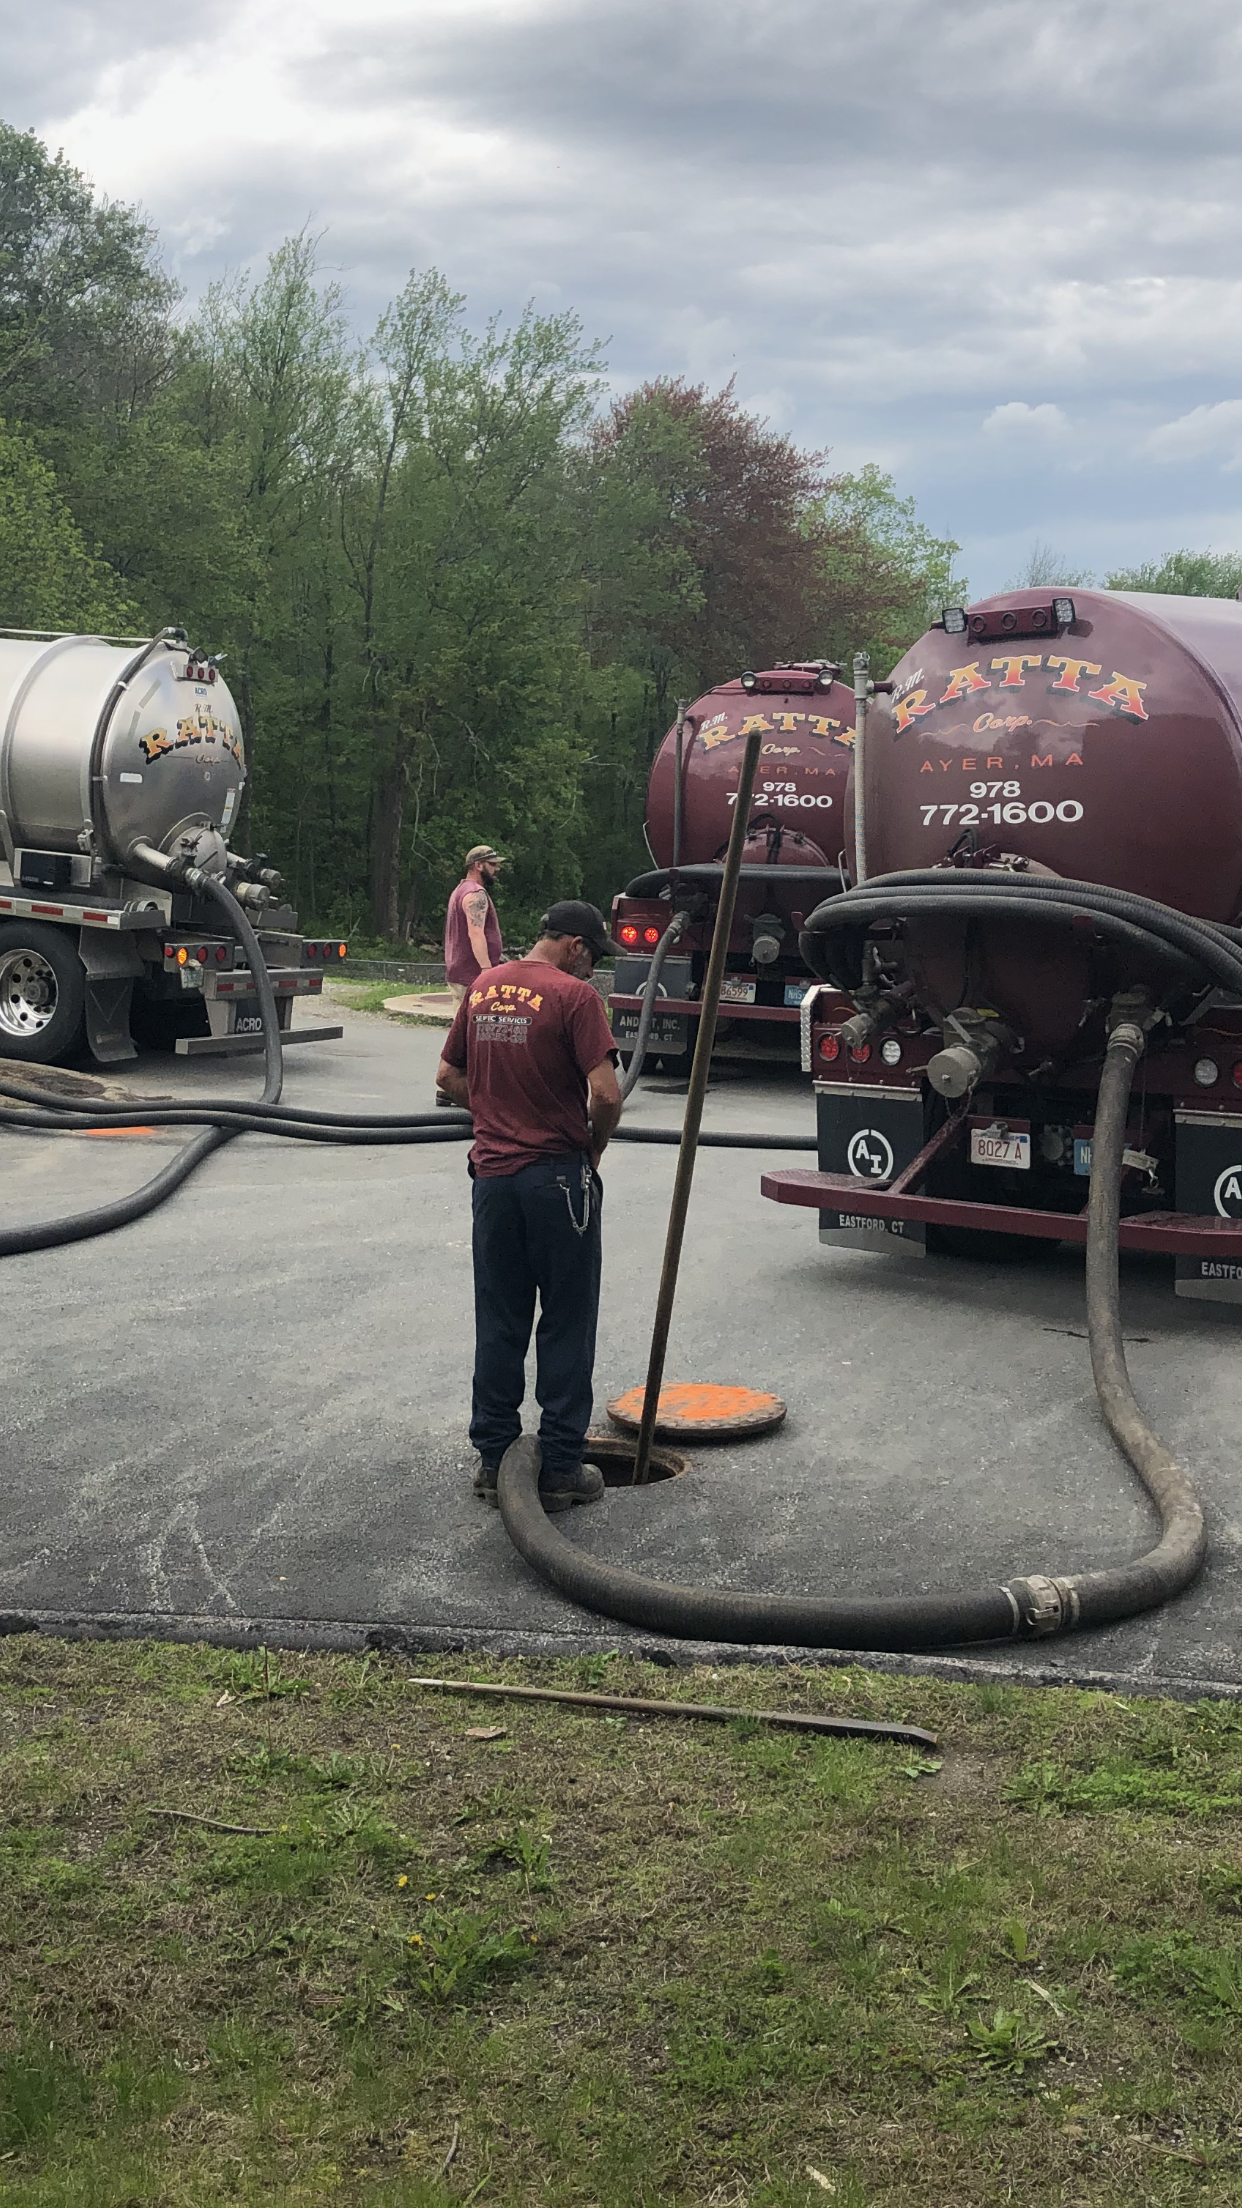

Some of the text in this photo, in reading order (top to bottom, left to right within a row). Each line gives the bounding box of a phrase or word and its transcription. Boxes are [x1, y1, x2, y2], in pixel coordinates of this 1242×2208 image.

[891, 668, 925, 703] R.M.
[892, 654, 1150, 736] RATTA
[700, 711, 728, 731] R.M.
[973, 713, 1033, 734] Corp.
[139, 716, 243, 768] RATTA
[761, 743, 801, 757] Corp.
[1031, 753, 1084, 767] MA
[728, 765, 836, 776] AER, MA
[762, 782, 797, 792] 978
[970, 780, 1021, 798] 978
[726, 793, 833, 808] 72-1600
[920, 800, 1084, 826] 772-1600
[471, 985, 543, 1011] RATTA
[236, 1017, 262, 1032] ACRO
[619, 1015, 681, 1030] ANDT, INC.
[978, 1138, 1022, 1160] 8027 A
[891, 1221, 905, 1234] CT
